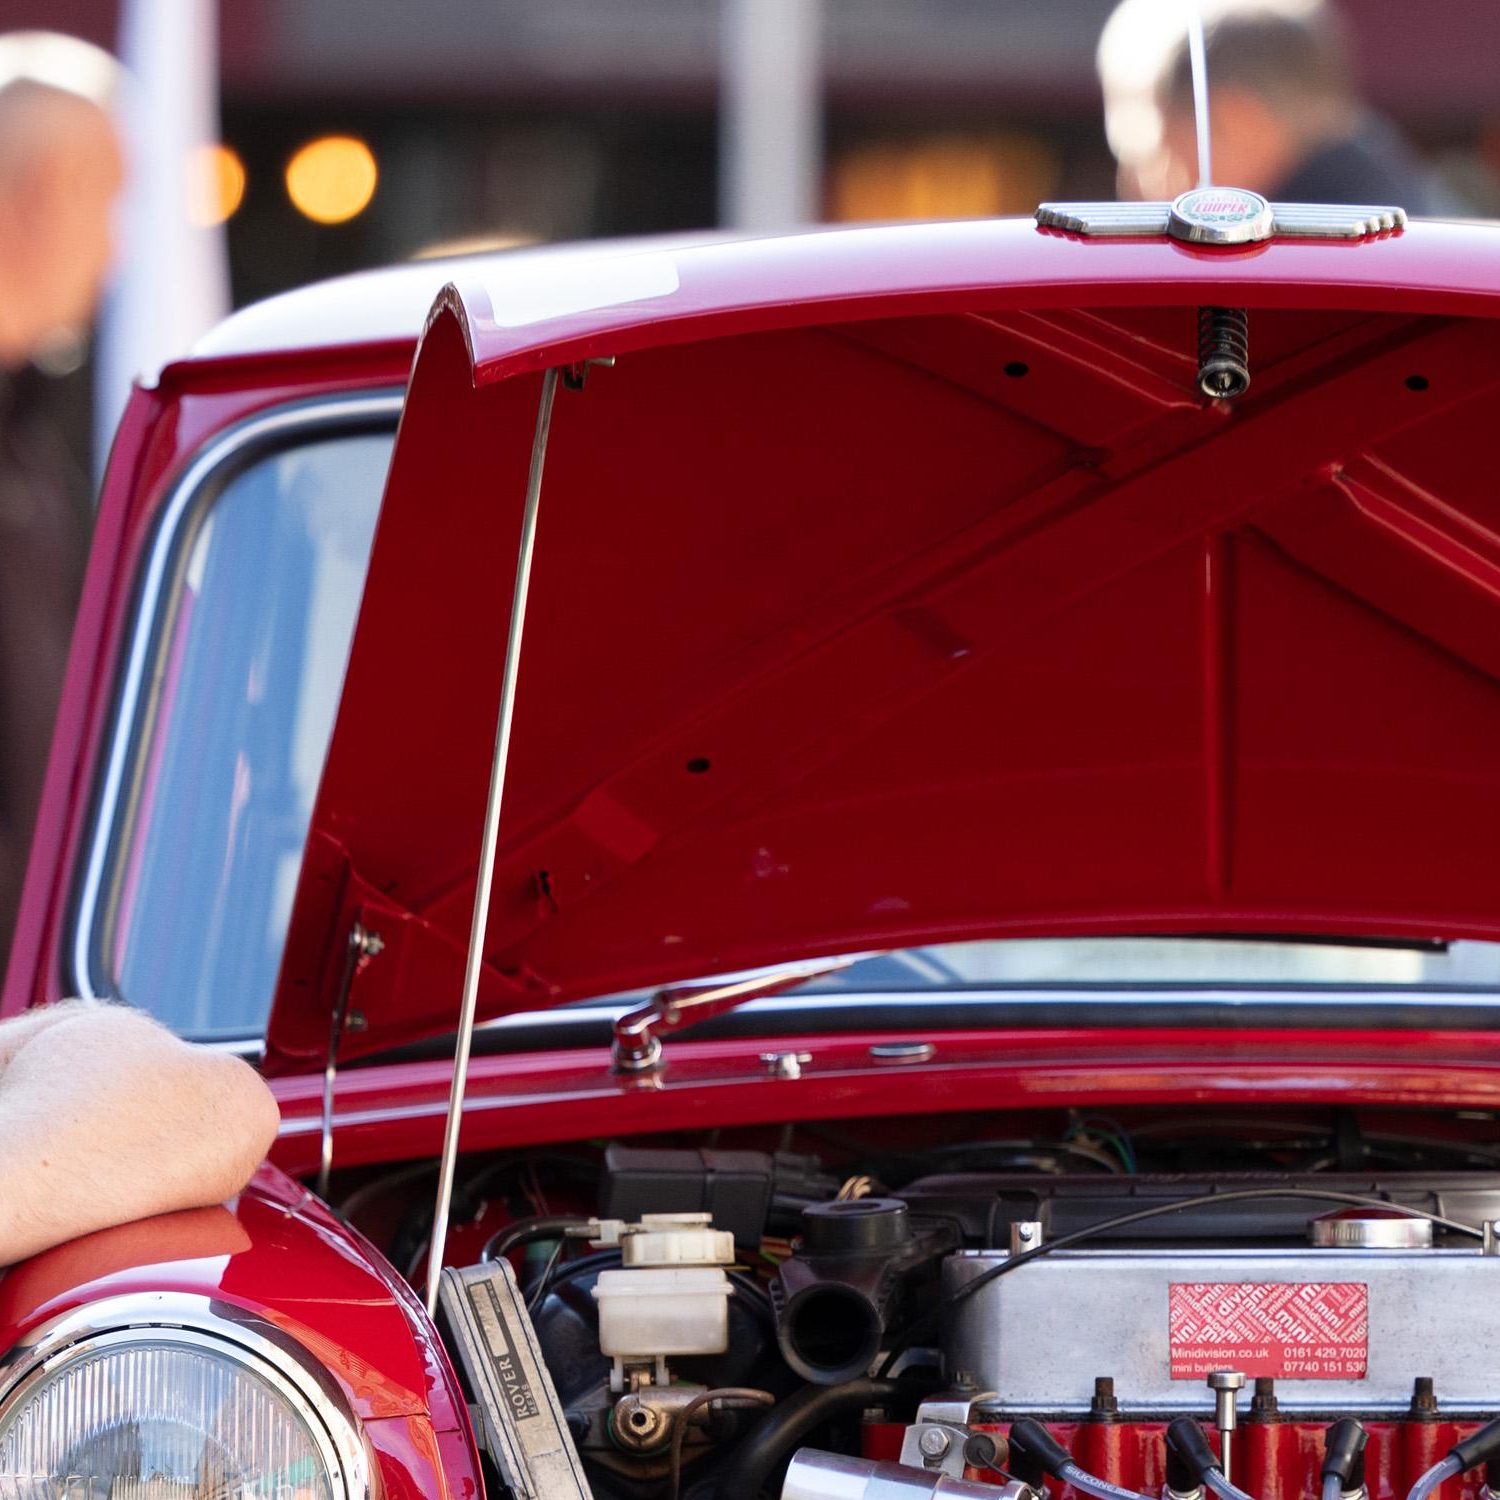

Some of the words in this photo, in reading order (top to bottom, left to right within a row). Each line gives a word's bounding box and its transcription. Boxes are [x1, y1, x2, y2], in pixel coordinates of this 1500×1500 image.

[1194, 203, 1249, 212] COOPER
[1171, 1347, 1269, 1359] Minidivision.co.uk
[1284, 1348, 1311, 1358] 0161
[1314, 1348, 1337, 1359] 429
[1340, 1348, 1366, 1359] 7020
[1172, 1363, 1193, 1373] mini
[1284, 1361, 1319, 1372] 07740
[1323, 1361, 1342, 1372] 151
[499, 1357, 529, 1418] ROVER
